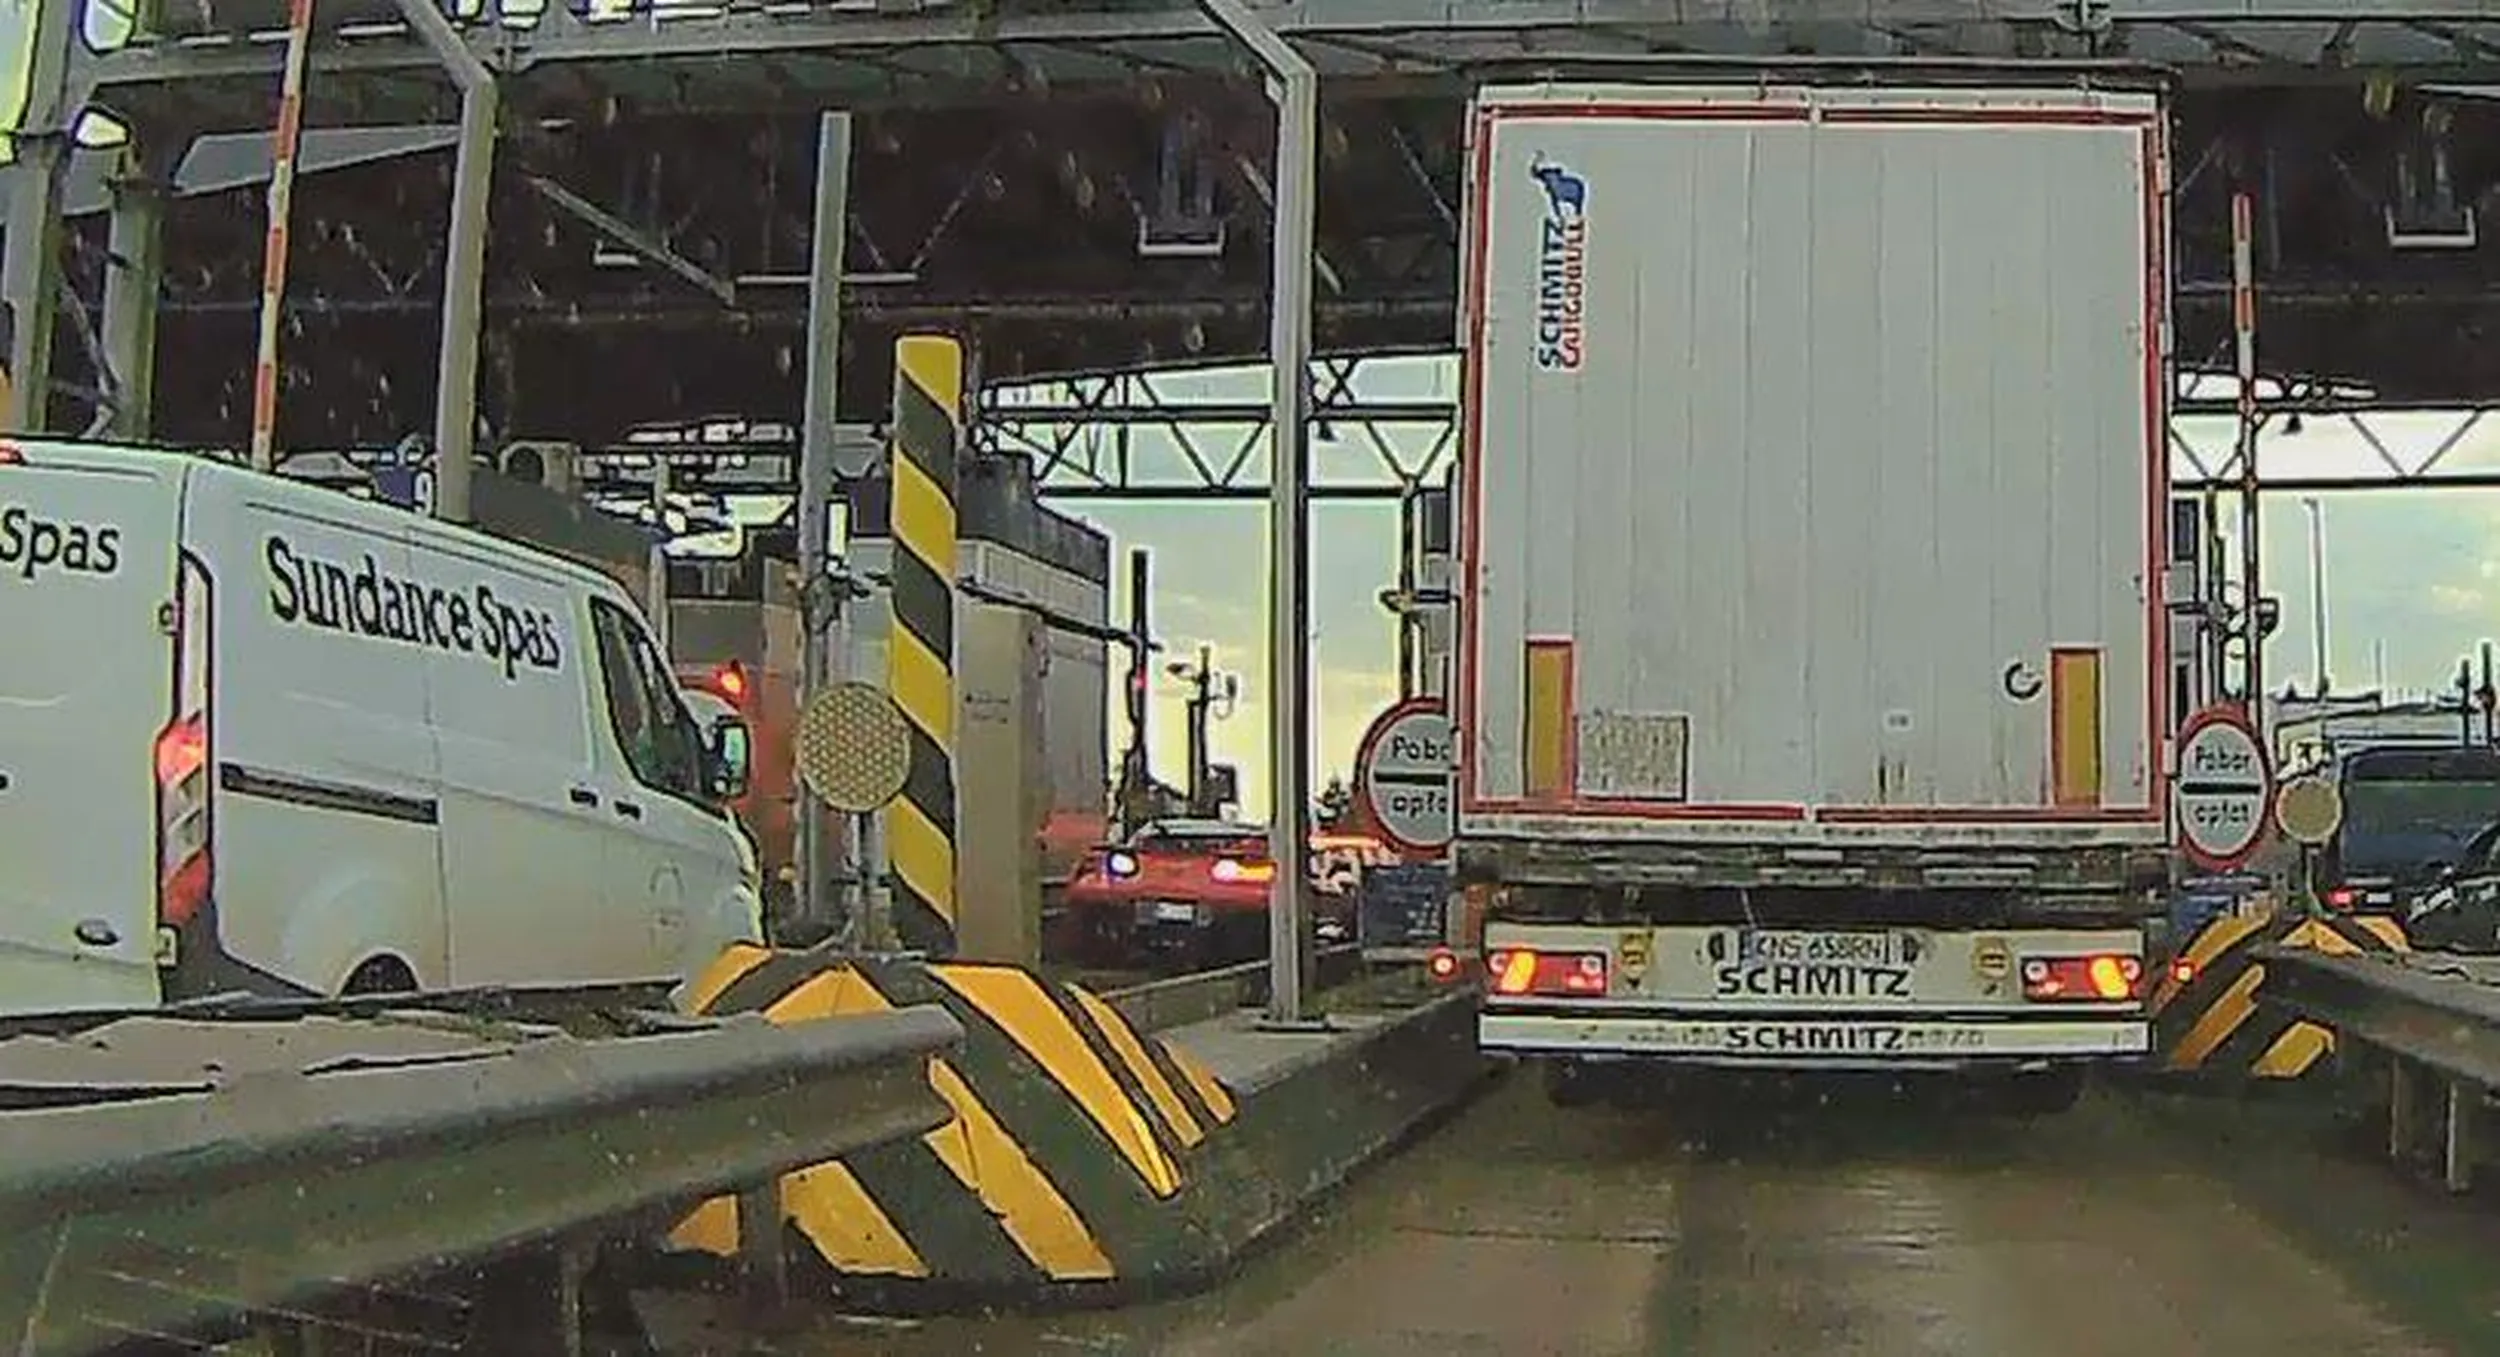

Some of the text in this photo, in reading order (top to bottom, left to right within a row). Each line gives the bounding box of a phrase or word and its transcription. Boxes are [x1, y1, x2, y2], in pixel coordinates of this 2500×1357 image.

[1538, 216, 1564, 369] SCHMITZ
[0, 507, 120, 580] Spas
[266, 536, 561, 681] Sundance Spas
[1717, 965, 1911, 997] SCHMITZ
[1725, 1025, 1904, 1050] SCHMITZ
